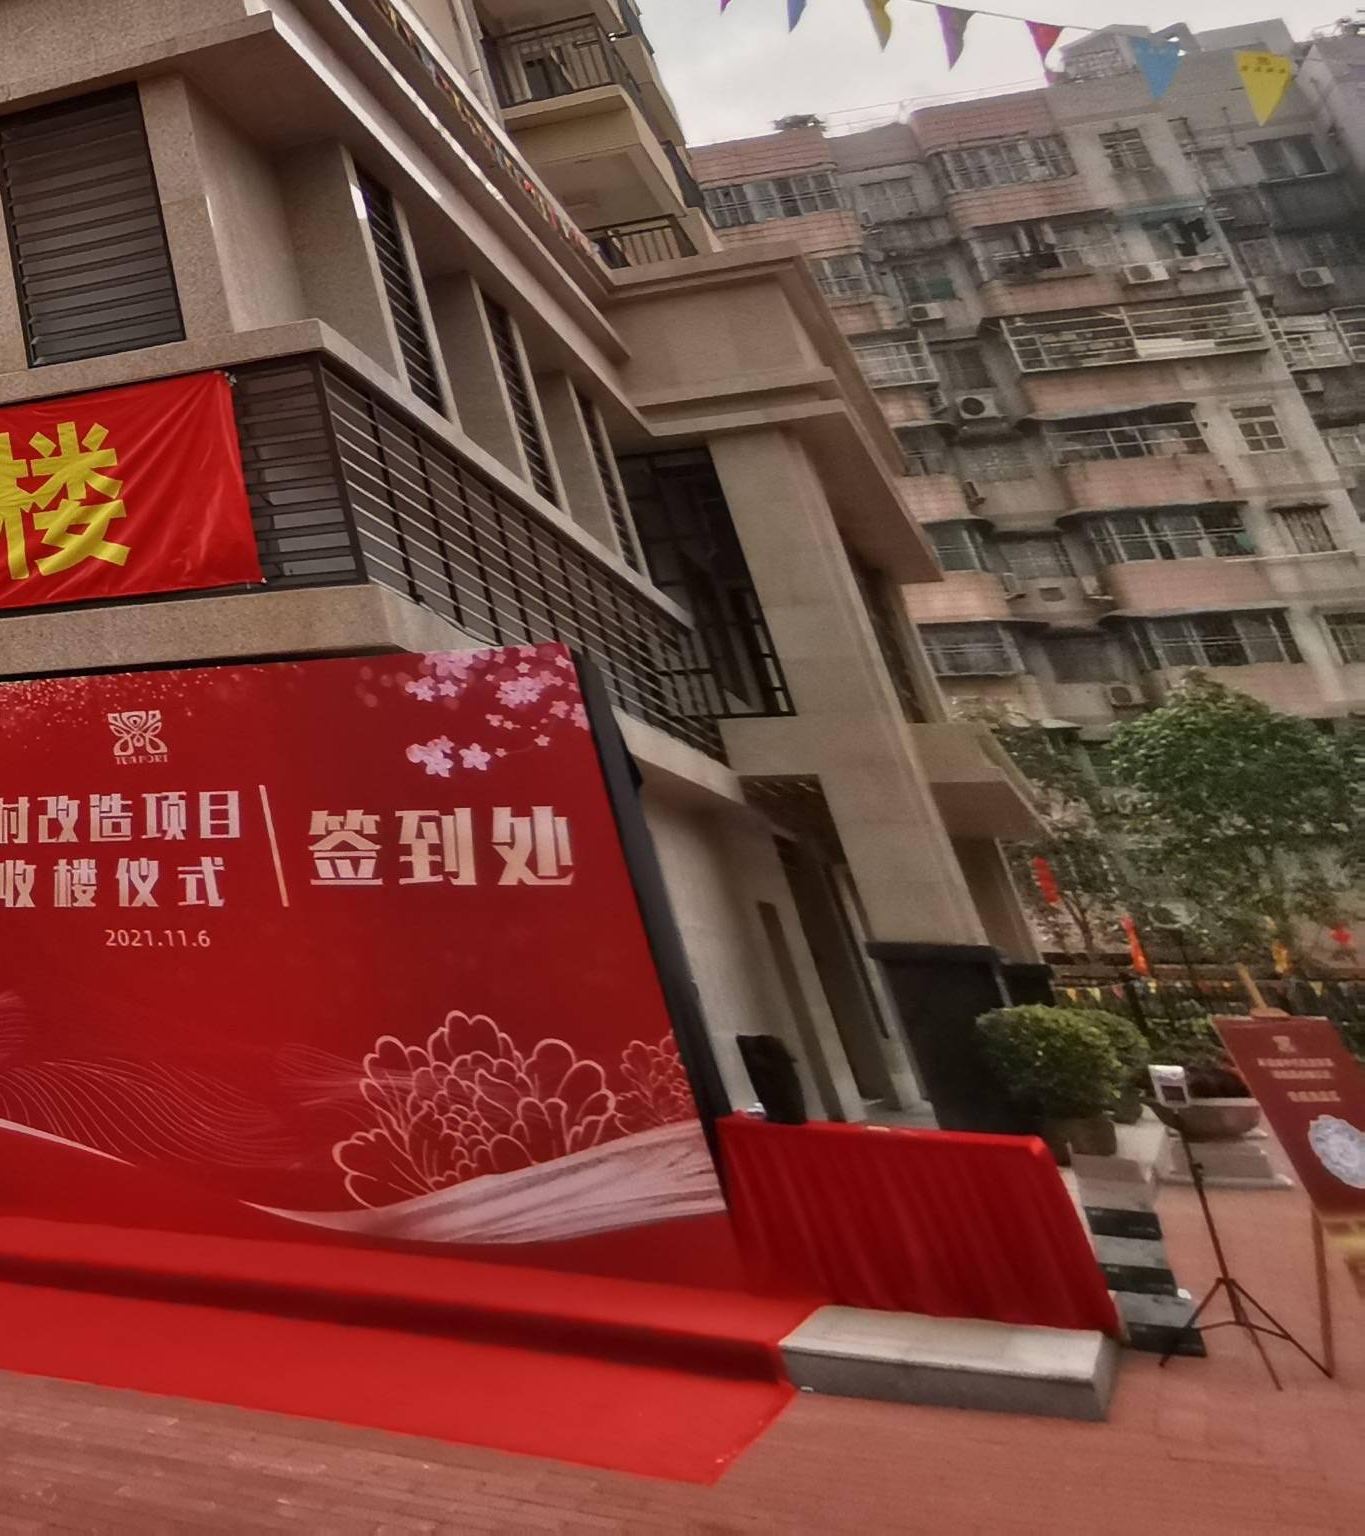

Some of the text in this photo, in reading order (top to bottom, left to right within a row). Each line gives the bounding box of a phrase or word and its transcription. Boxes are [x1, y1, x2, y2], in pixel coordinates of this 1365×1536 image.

[308, 805, 574, 886] 签到处
[105, 929, 211, 948] 2021.11.6
